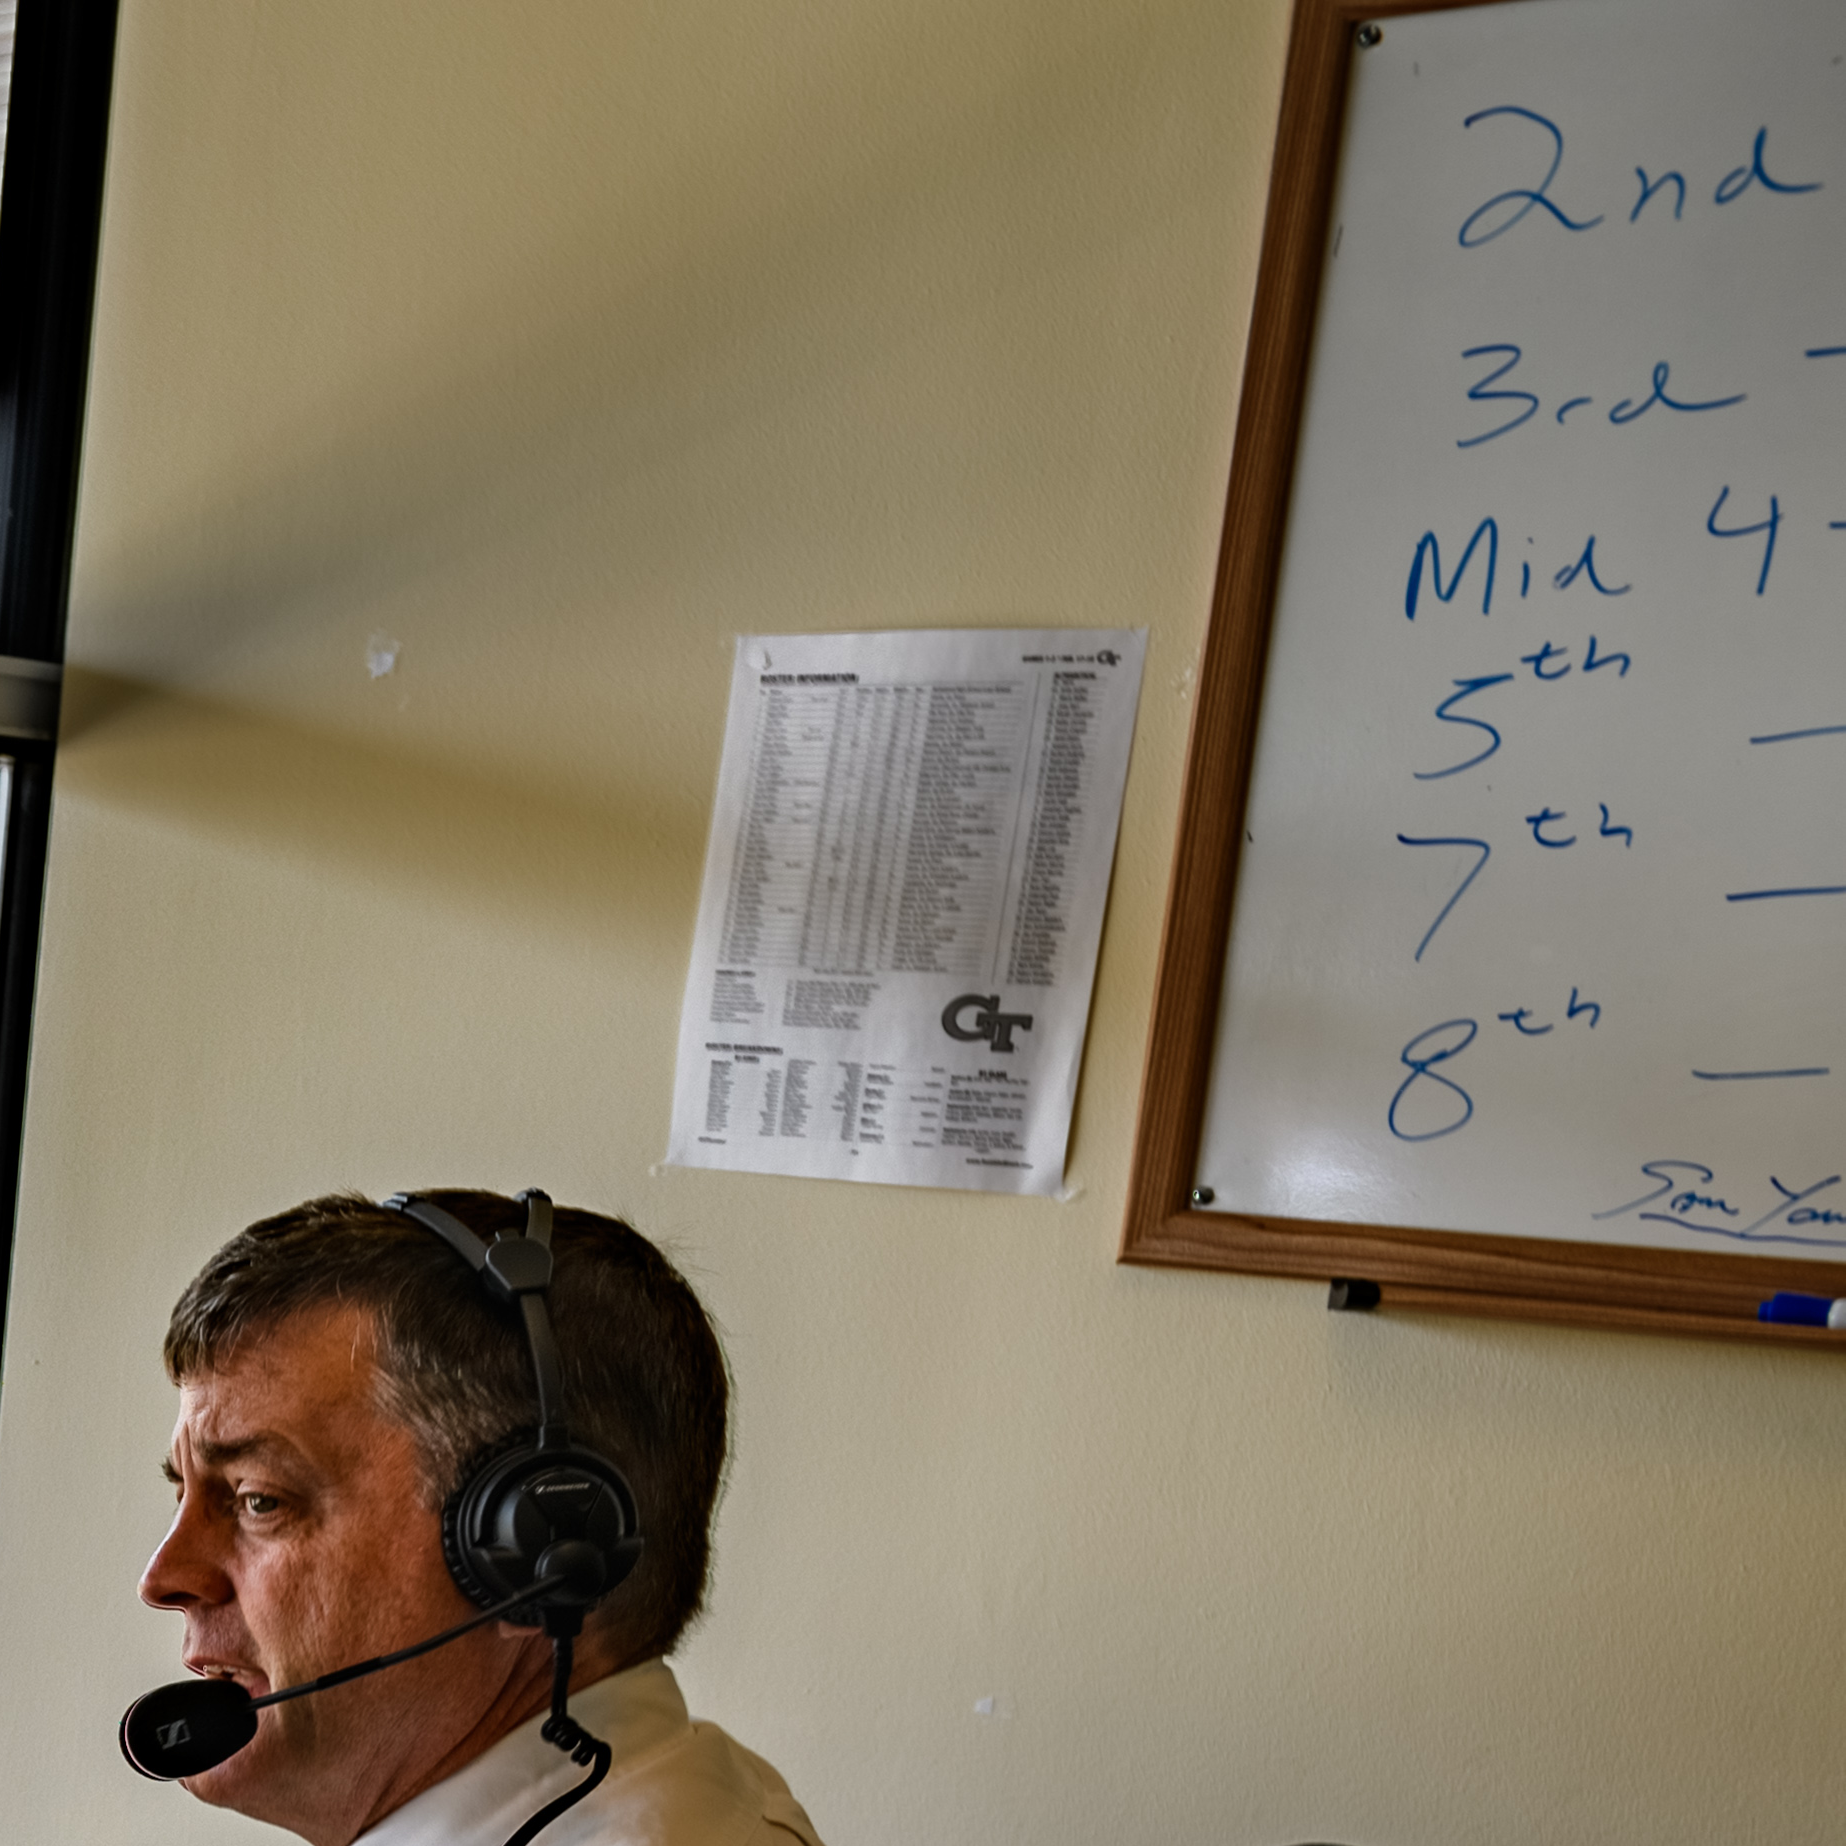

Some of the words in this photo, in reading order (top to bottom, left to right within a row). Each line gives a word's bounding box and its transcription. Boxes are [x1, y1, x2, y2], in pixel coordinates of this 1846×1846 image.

[1458, 105, 1824, 248] 2nd
[1456, 344, 1748, 448] 3rd
[1406, 516, 1632, 621] Mid
[1706, 485, 1784, 595] 4
[1413, 635, 1631, 780] 5th
[1396, 802, 1633, 963] 7th
[1387, 986, 1601, 1142] 8th
